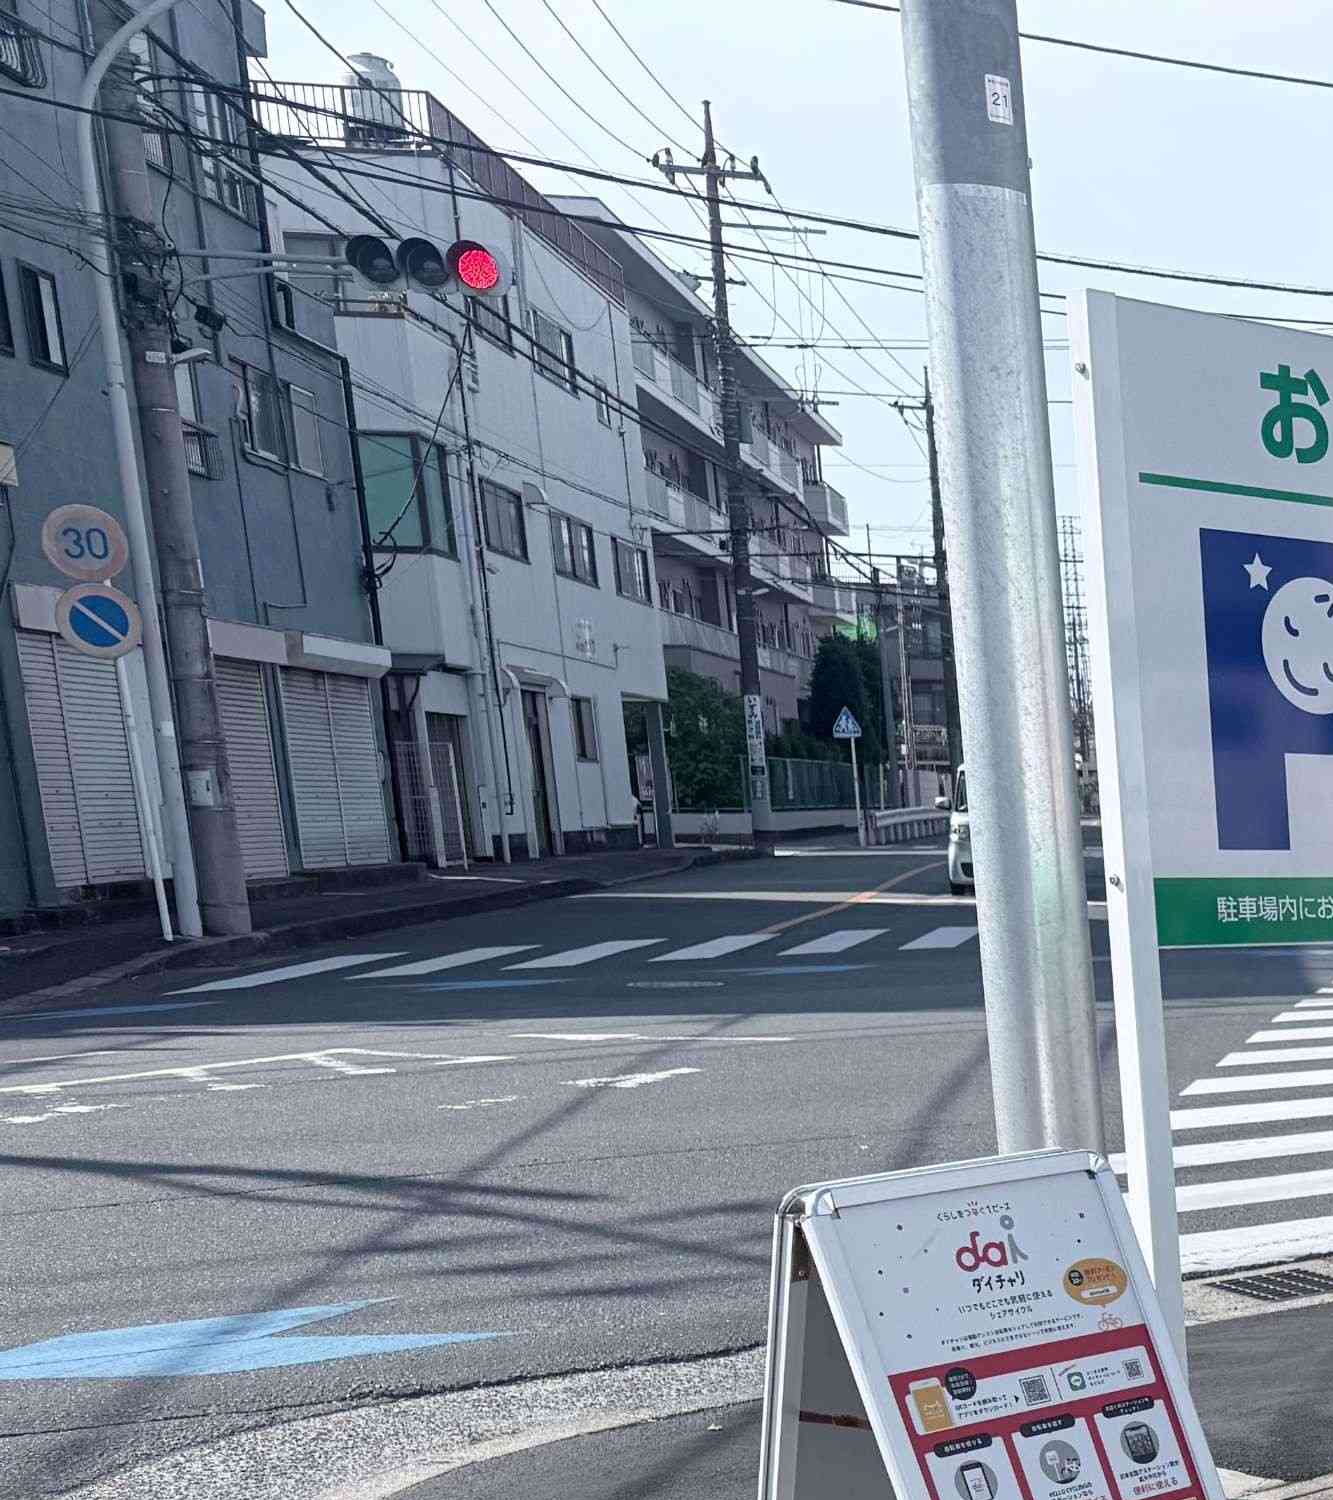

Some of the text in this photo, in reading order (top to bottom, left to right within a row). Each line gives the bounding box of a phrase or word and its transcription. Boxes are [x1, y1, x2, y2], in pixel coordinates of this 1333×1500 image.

[991, 92, 1009, 108] 21
[62, 527, 109, 560] 30
[956, 1214, 1029, 1272] dai
[972, 1270, 1026, 1294] ダイチャリ
[990, 1305, 1033, 1320] シェアサイクル
